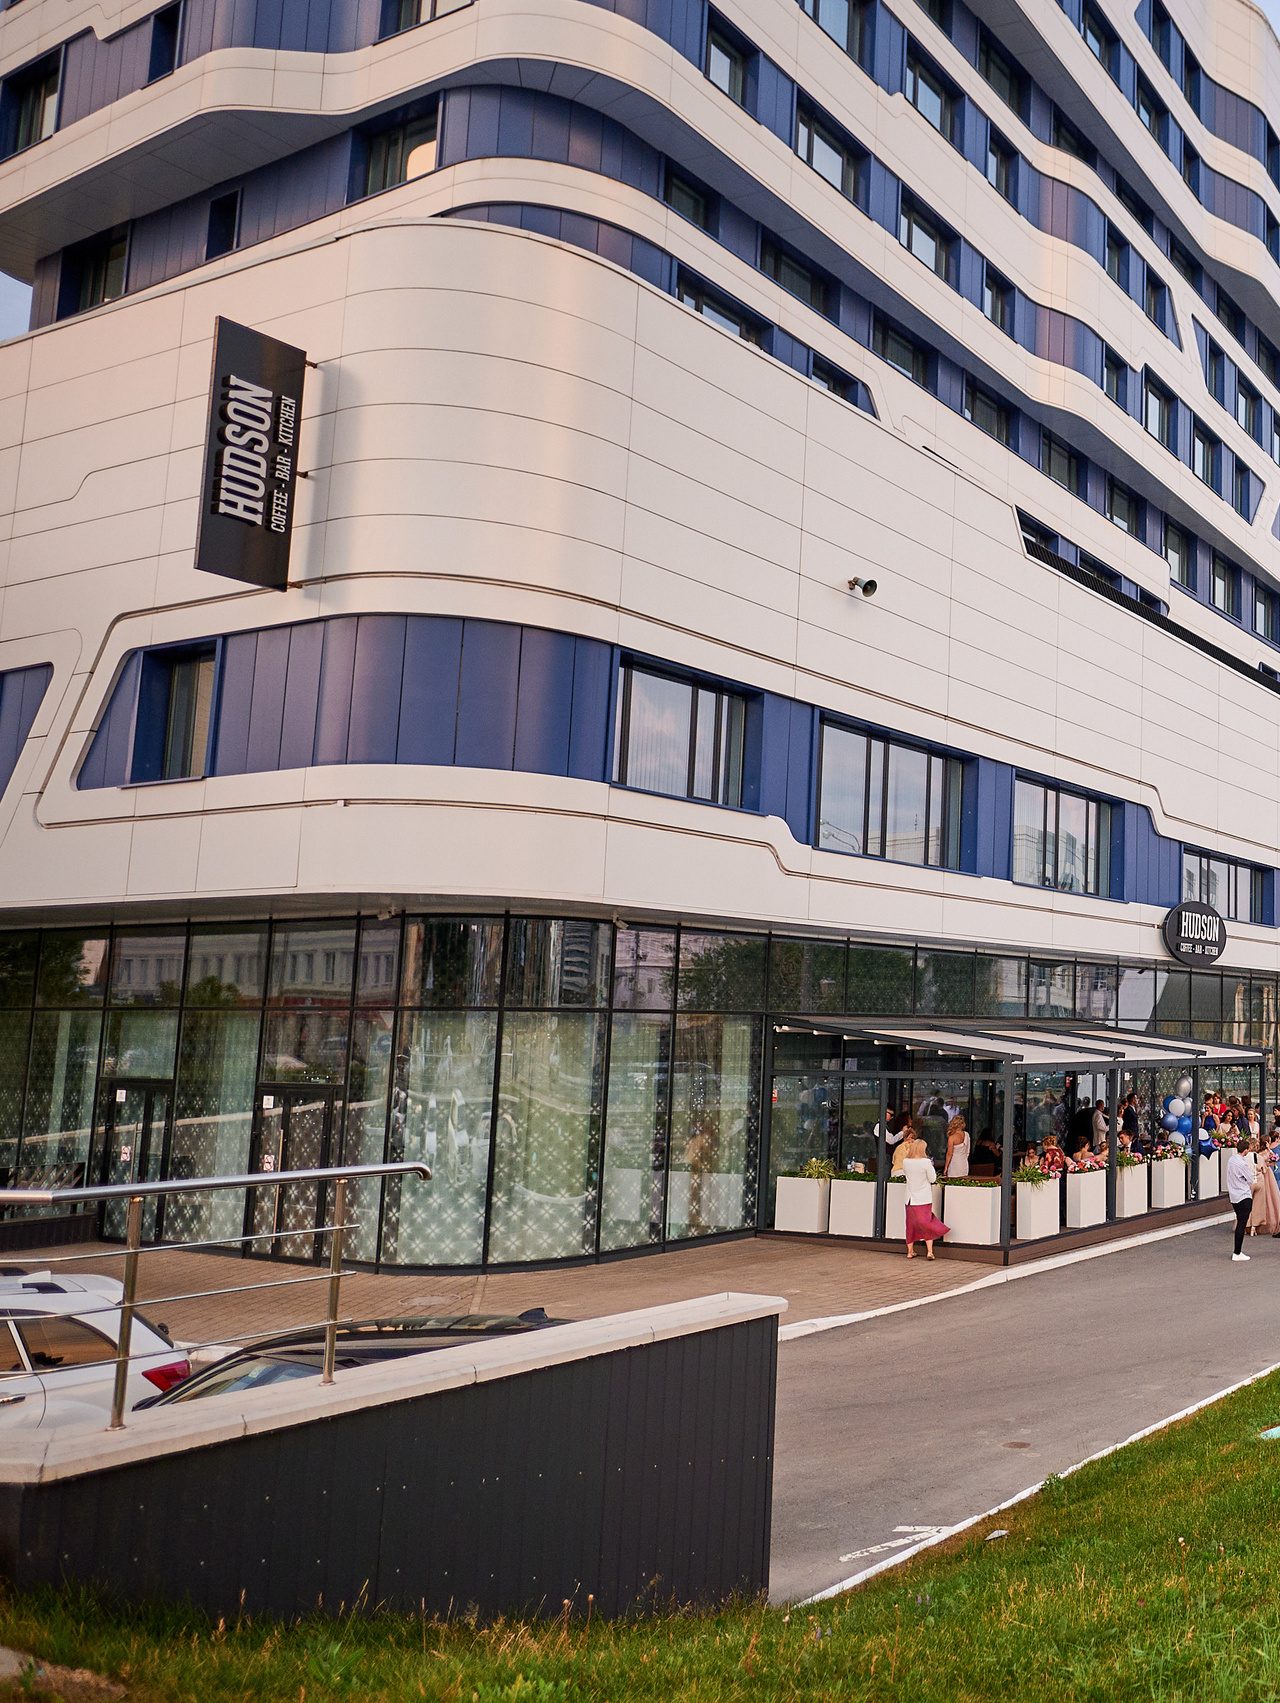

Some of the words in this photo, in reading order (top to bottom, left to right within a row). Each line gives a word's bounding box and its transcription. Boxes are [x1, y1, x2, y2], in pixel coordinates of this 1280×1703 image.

[278, 395, 296, 447] KITCHEN
[218, 374, 273, 526] HUDSON
[275, 454, 292, 482] BAR
[271, 490, 289, 533] COFFEE
[1180, 911, 1219, 942] HUDSON
